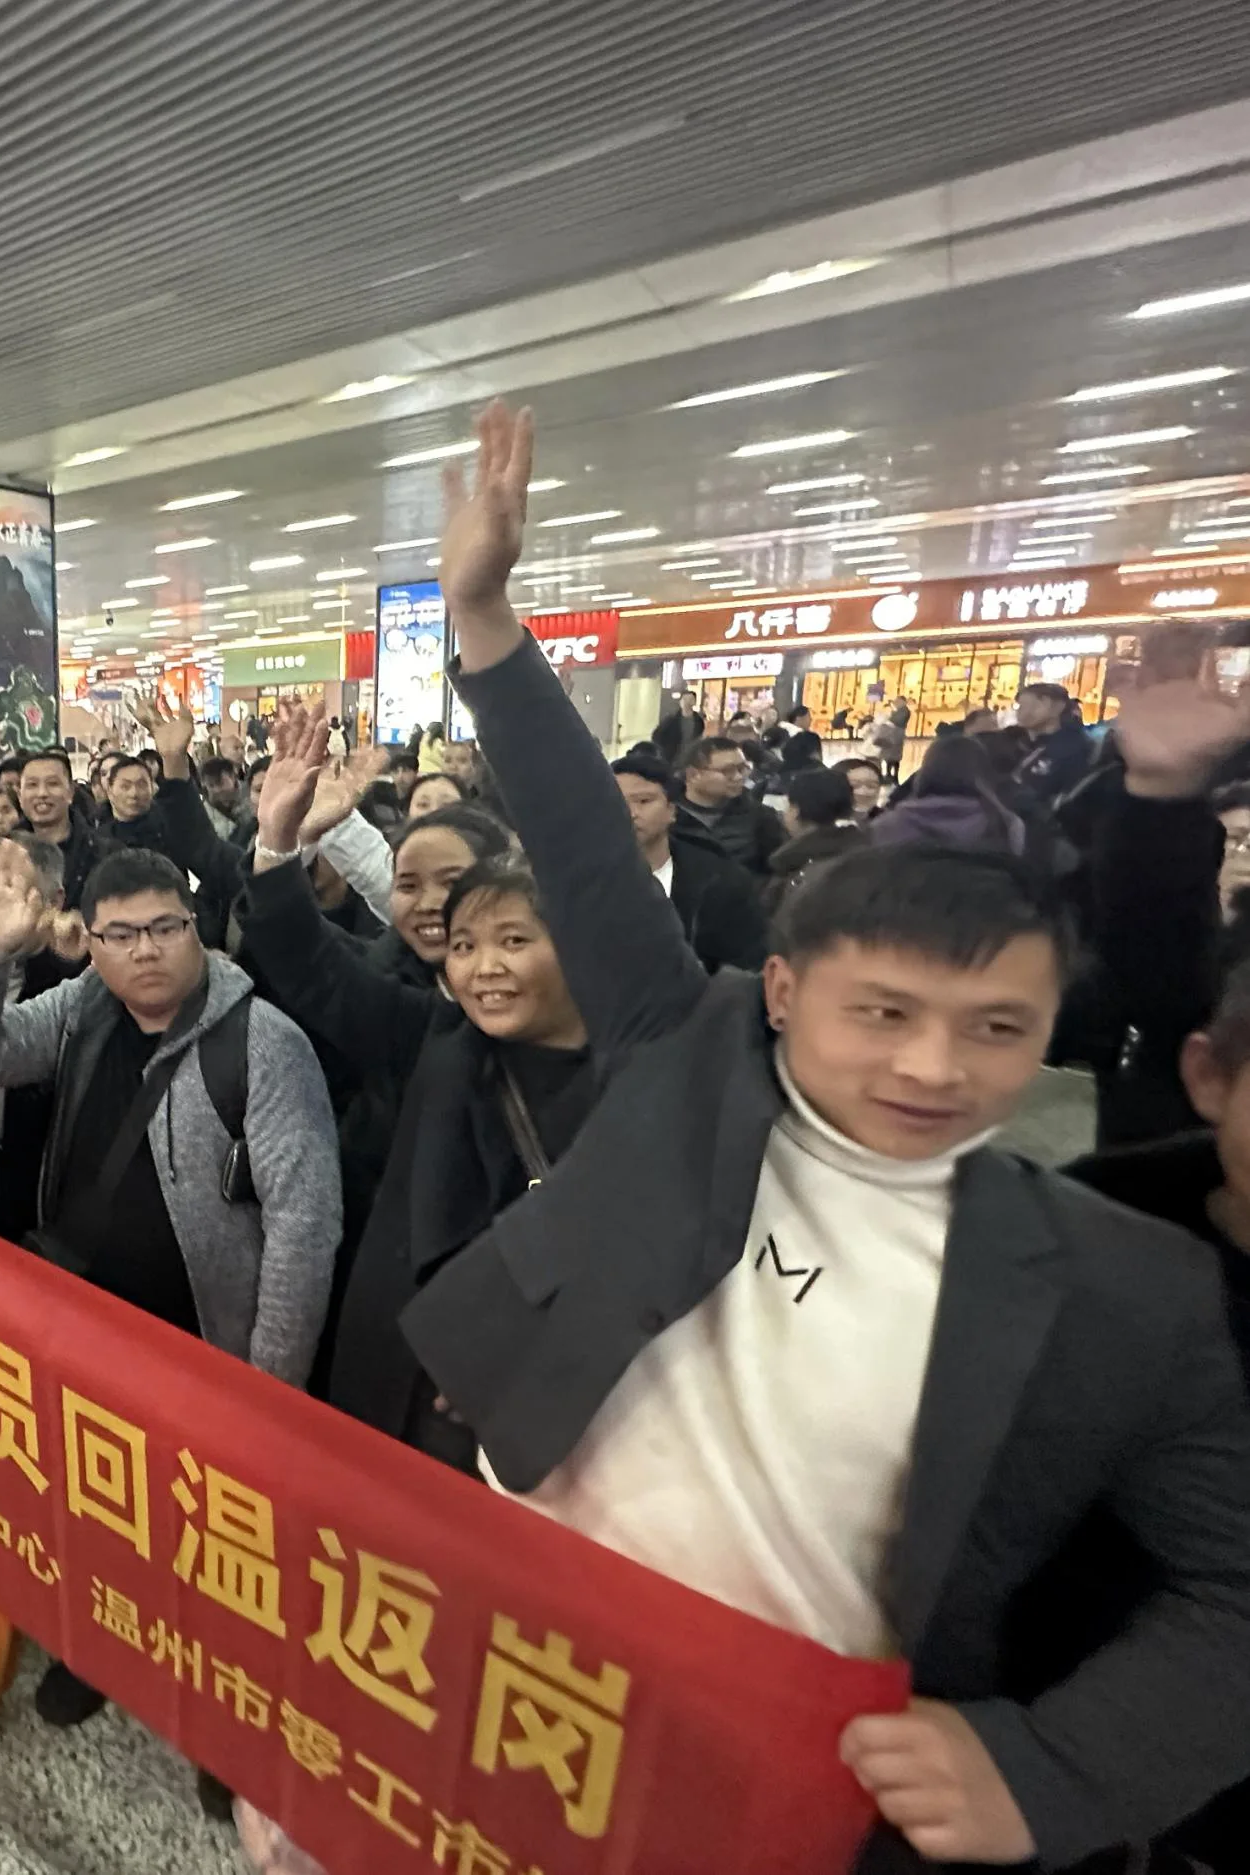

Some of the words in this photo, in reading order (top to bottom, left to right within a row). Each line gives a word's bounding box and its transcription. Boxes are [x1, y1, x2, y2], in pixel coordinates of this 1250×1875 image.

[90, 1575, 545, 1875] 温州市零工市
